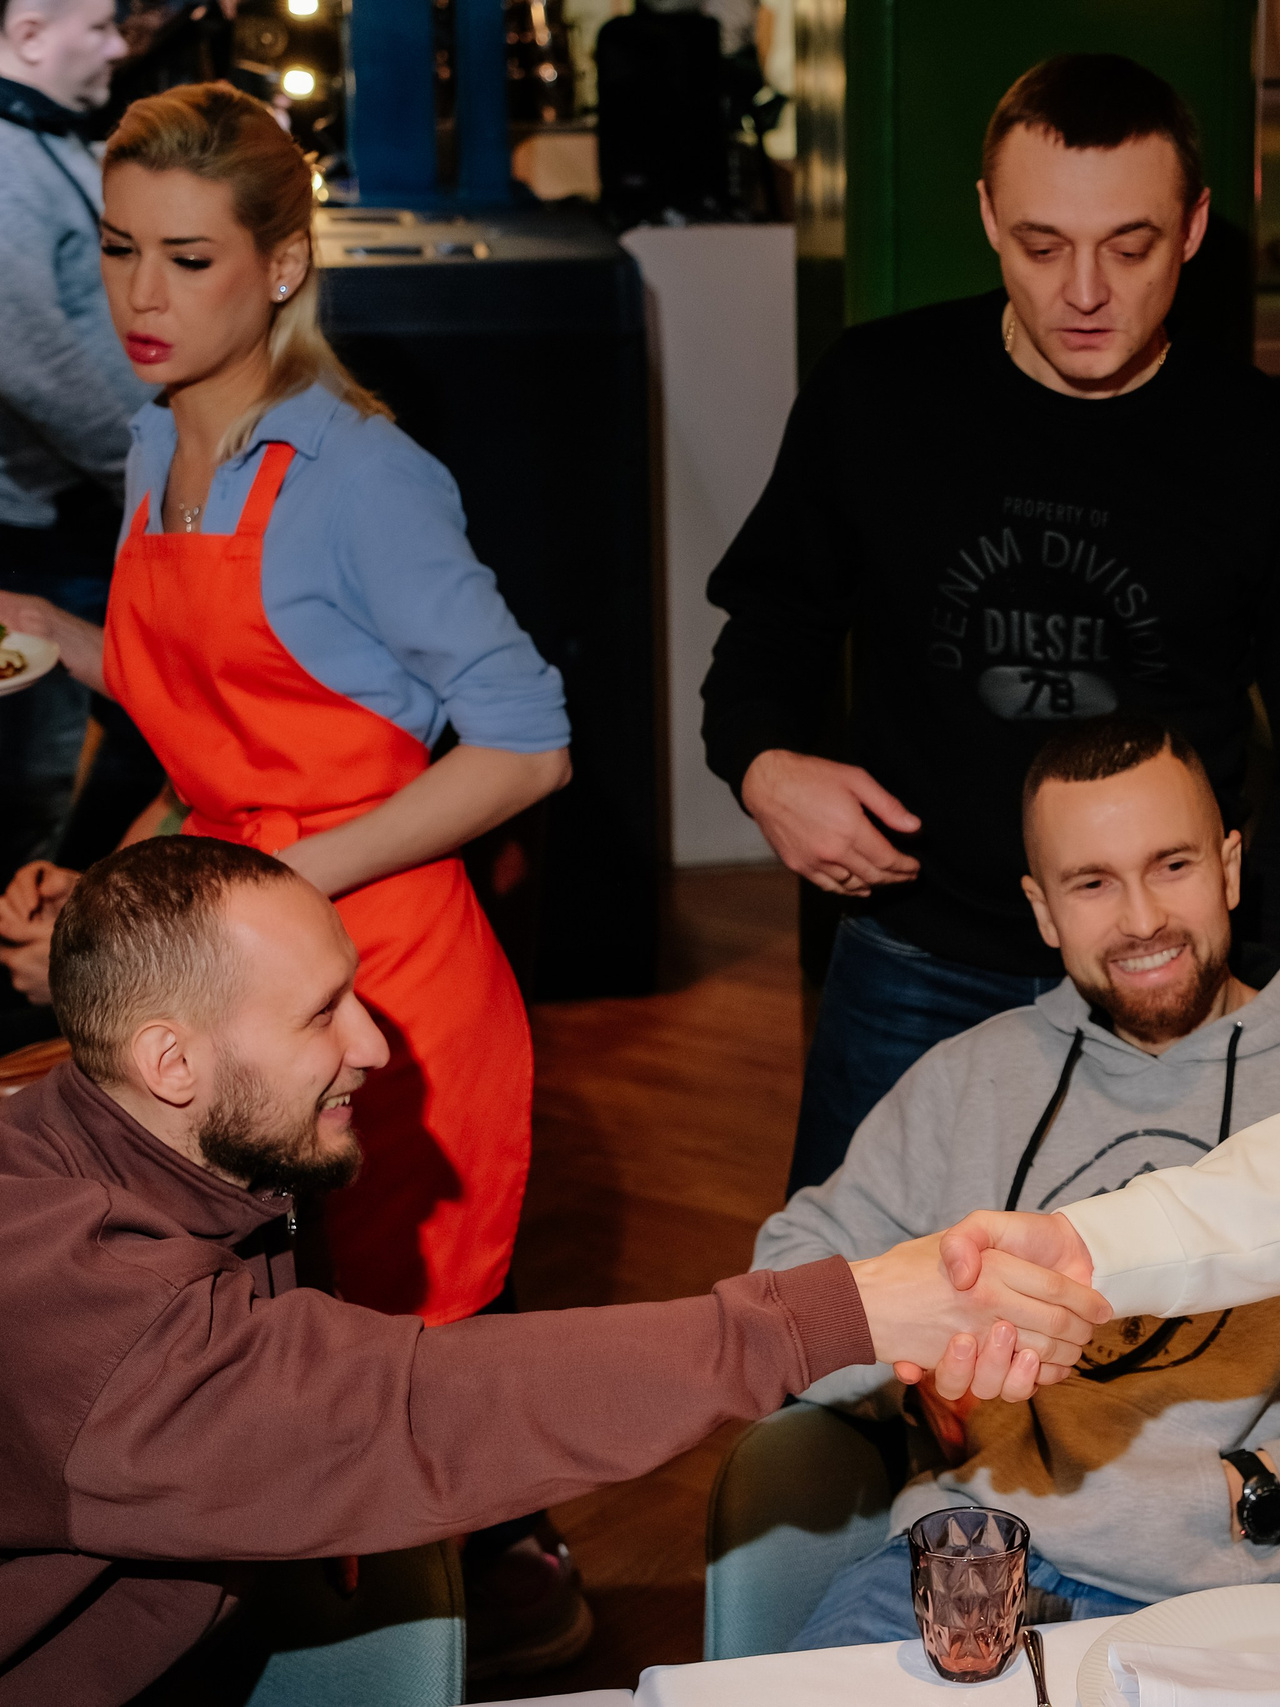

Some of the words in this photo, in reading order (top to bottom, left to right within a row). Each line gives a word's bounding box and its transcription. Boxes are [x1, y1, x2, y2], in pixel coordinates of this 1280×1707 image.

[1003, 496, 1083, 525] PROPERTY
[1089, 509, 1109, 528] OF
[928, 526, 1022, 670] DENIM
[1041, 530, 1168, 682] DIVISION
[983, 608, 1109, 662] DIESEL
[1020, 670, 1074, 713] 78
